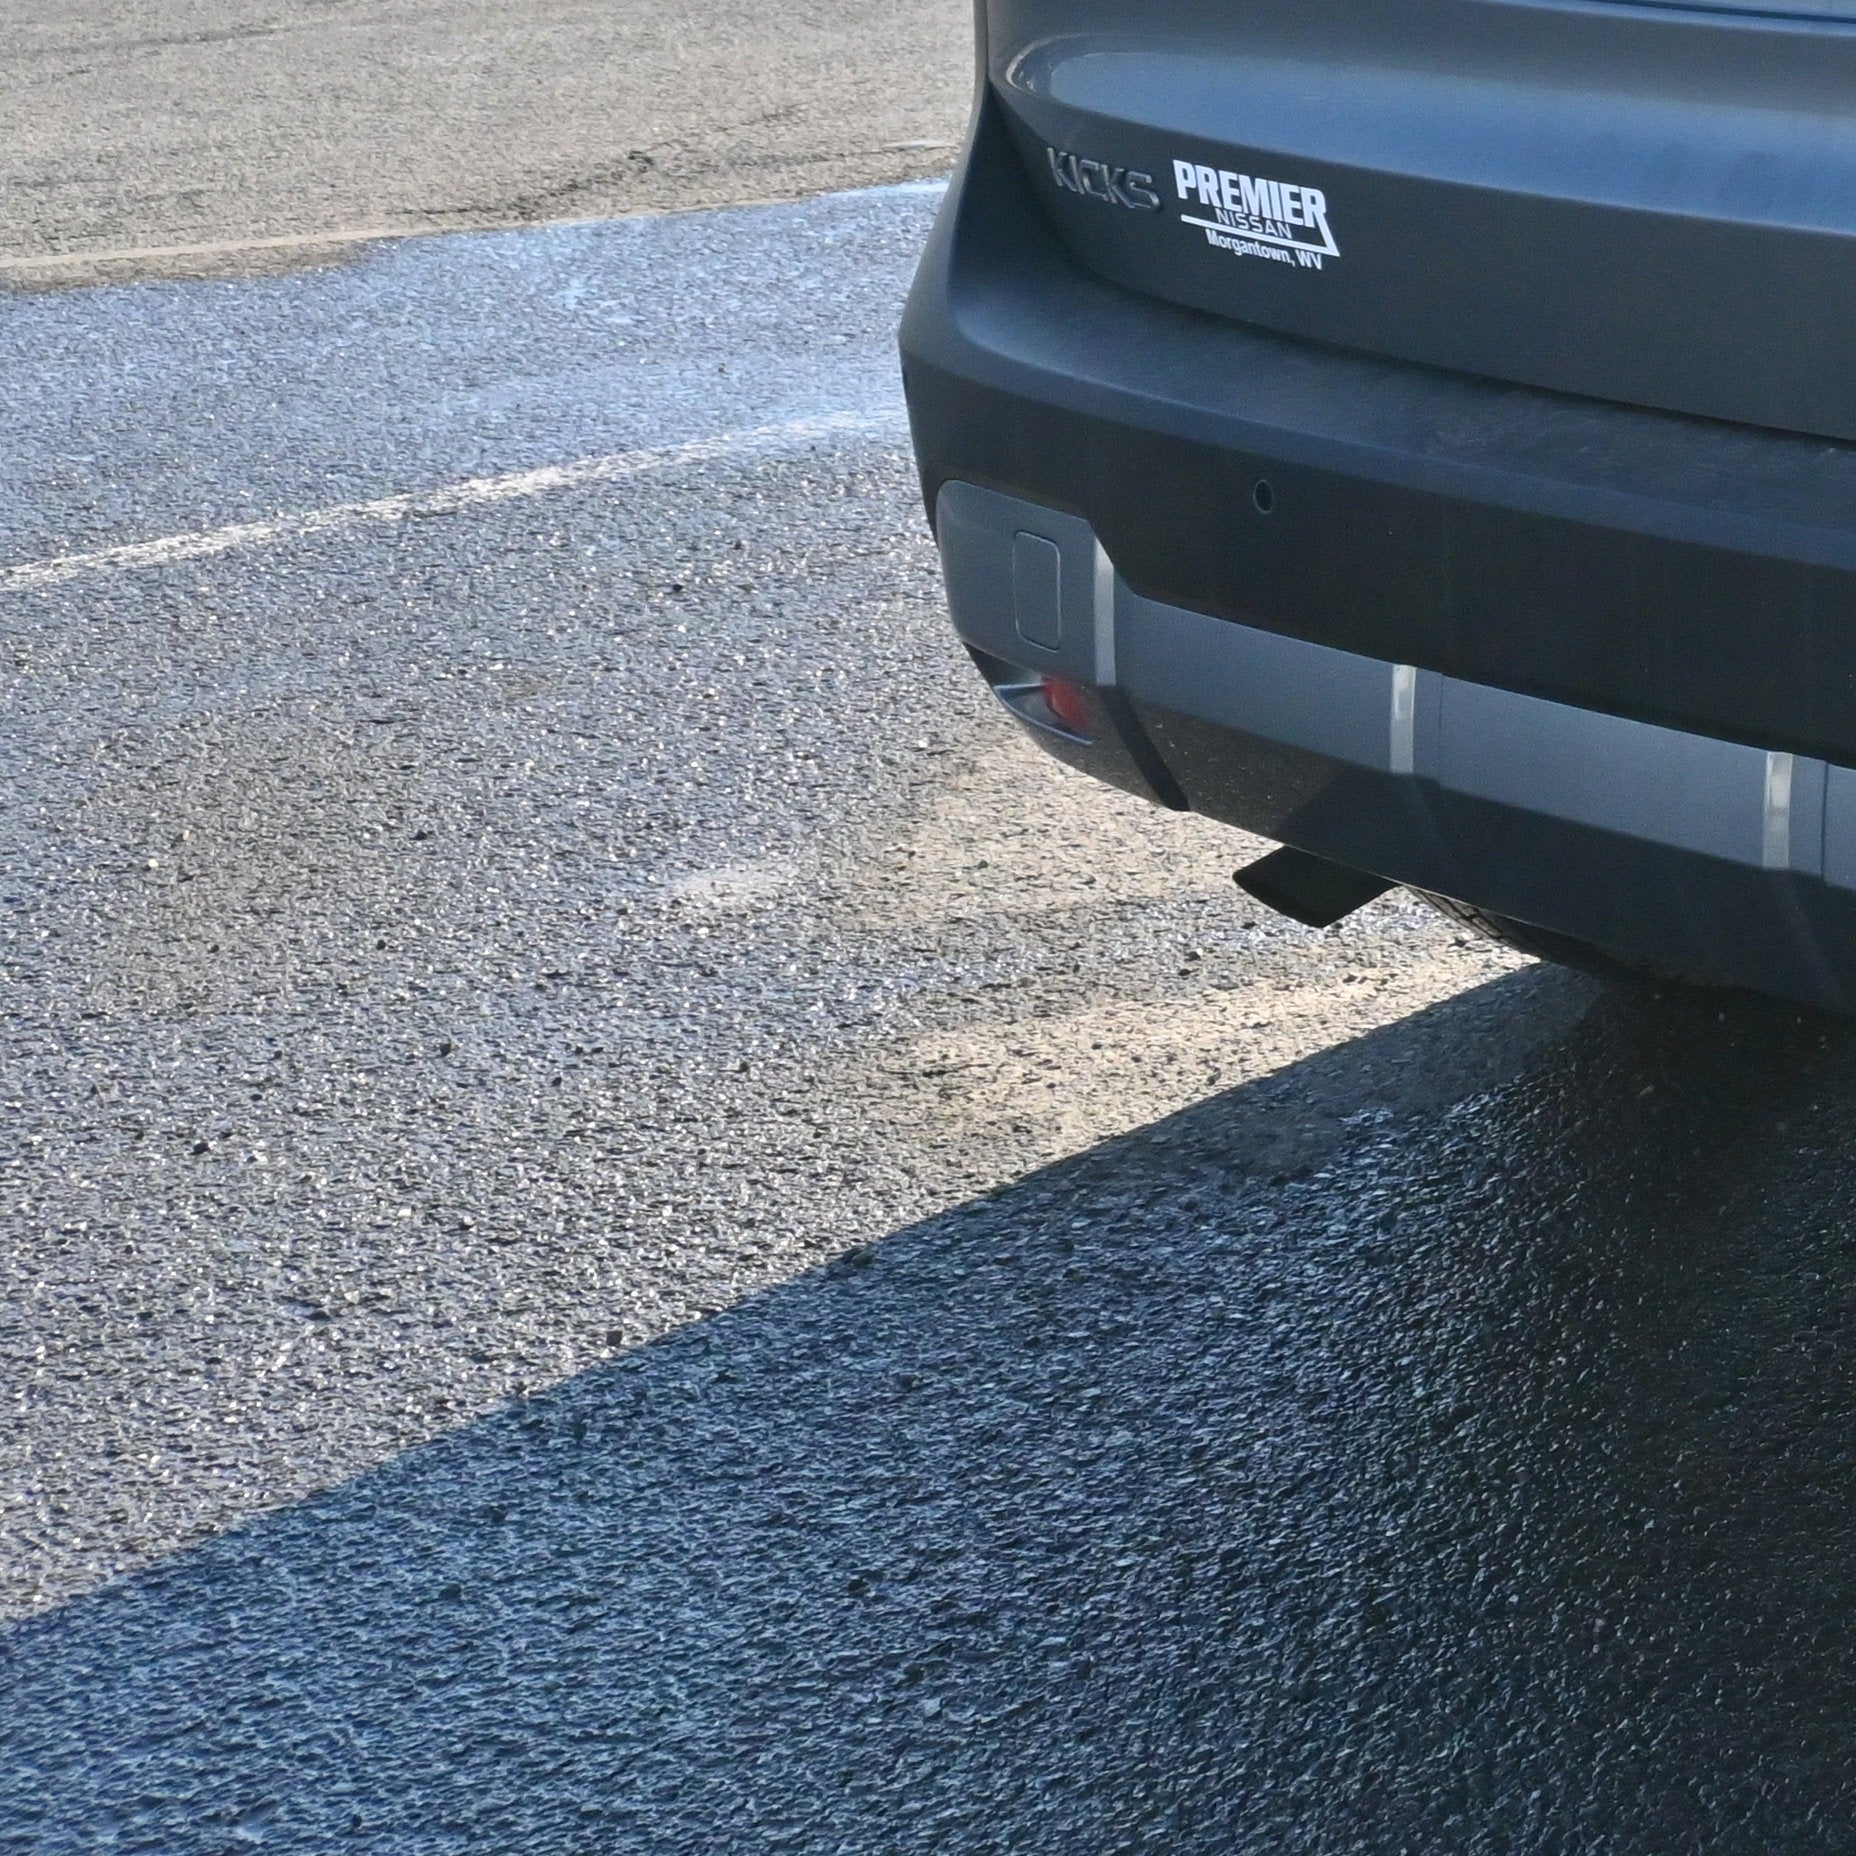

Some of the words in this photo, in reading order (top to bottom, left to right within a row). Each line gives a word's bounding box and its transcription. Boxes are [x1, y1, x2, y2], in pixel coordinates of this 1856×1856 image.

[1047, 146, 1161, 210] KICKS
[1173, 159, 1328, 230] PREMIER
[1205, 228, 1297, 268] Morgantown,
[1294, 249, 1323, 271] WV
[1214, 207, 1293, 240] NISSAN
